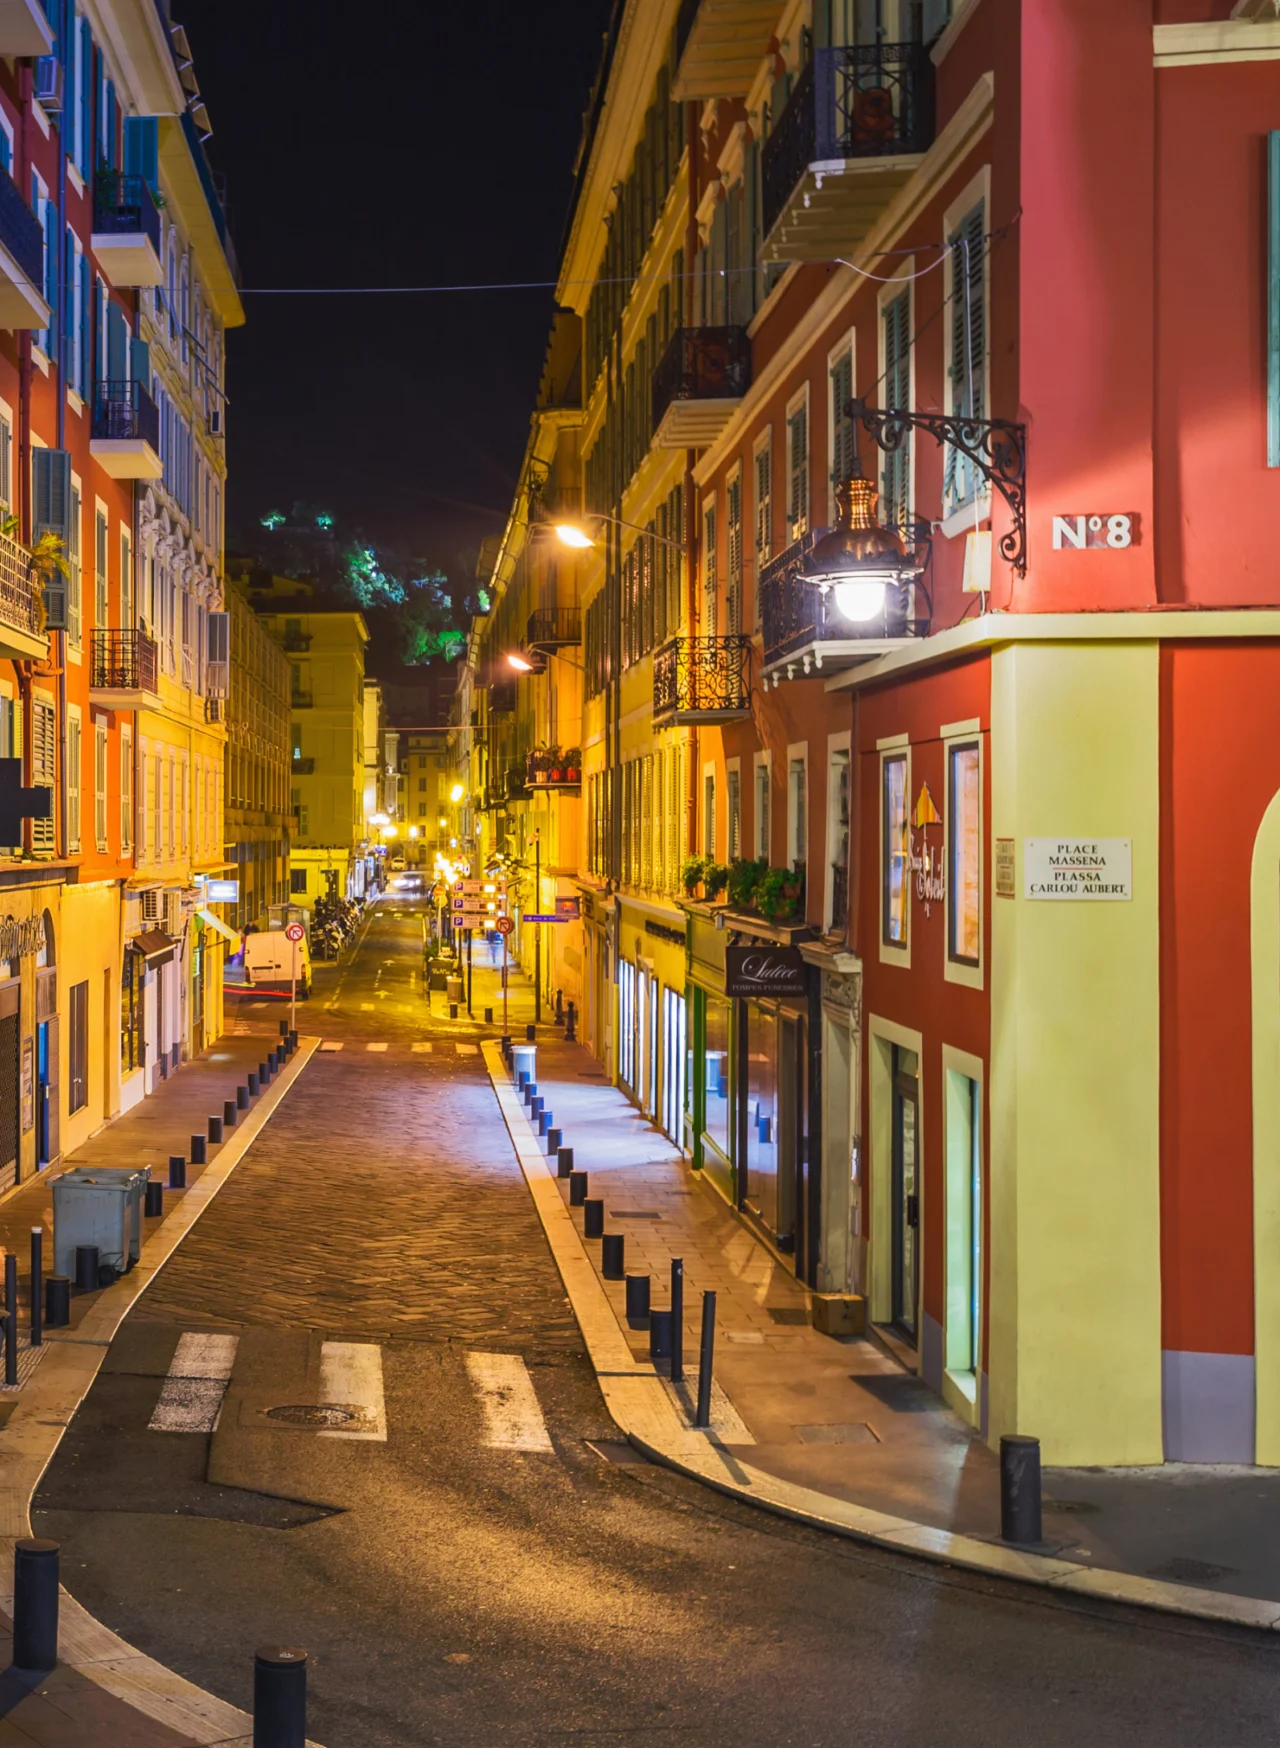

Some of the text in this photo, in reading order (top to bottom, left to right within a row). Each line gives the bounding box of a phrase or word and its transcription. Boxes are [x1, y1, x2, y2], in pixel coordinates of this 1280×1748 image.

[1057, 844, 1099, 854] PLACE
[1048, 855, 1107, 866] MASSENA
[1054, 872, 1102, 882] PLASSA
[1030, 883, 1126, 893] CARLOU AUBERT
